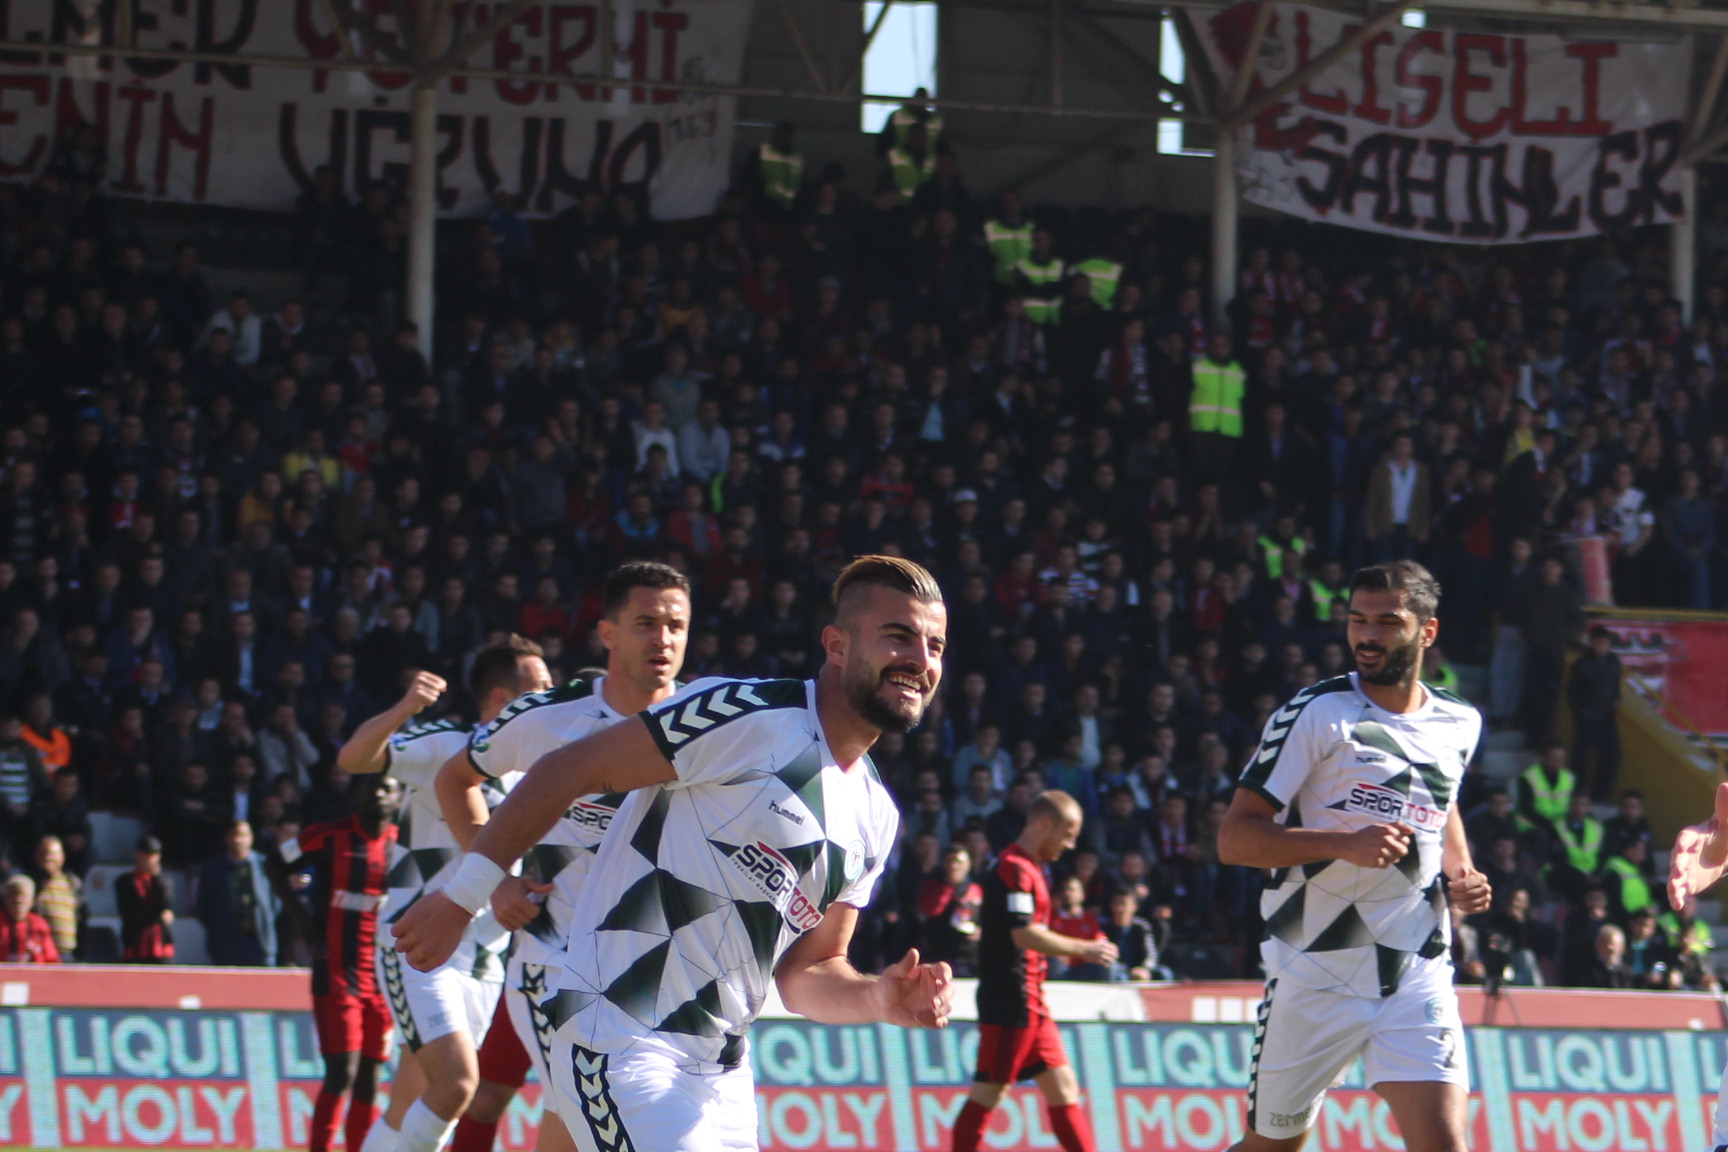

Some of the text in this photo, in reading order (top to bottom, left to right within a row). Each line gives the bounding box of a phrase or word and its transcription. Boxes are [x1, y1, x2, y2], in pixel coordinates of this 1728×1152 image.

[57, 1015, 241, 1079] LIQUI
[1113, 1030, 1251, 1088] LIQU
[1507, 1033, 1669, 1092] LIQUI
[65, 1083, 247, 1145] MOLY
